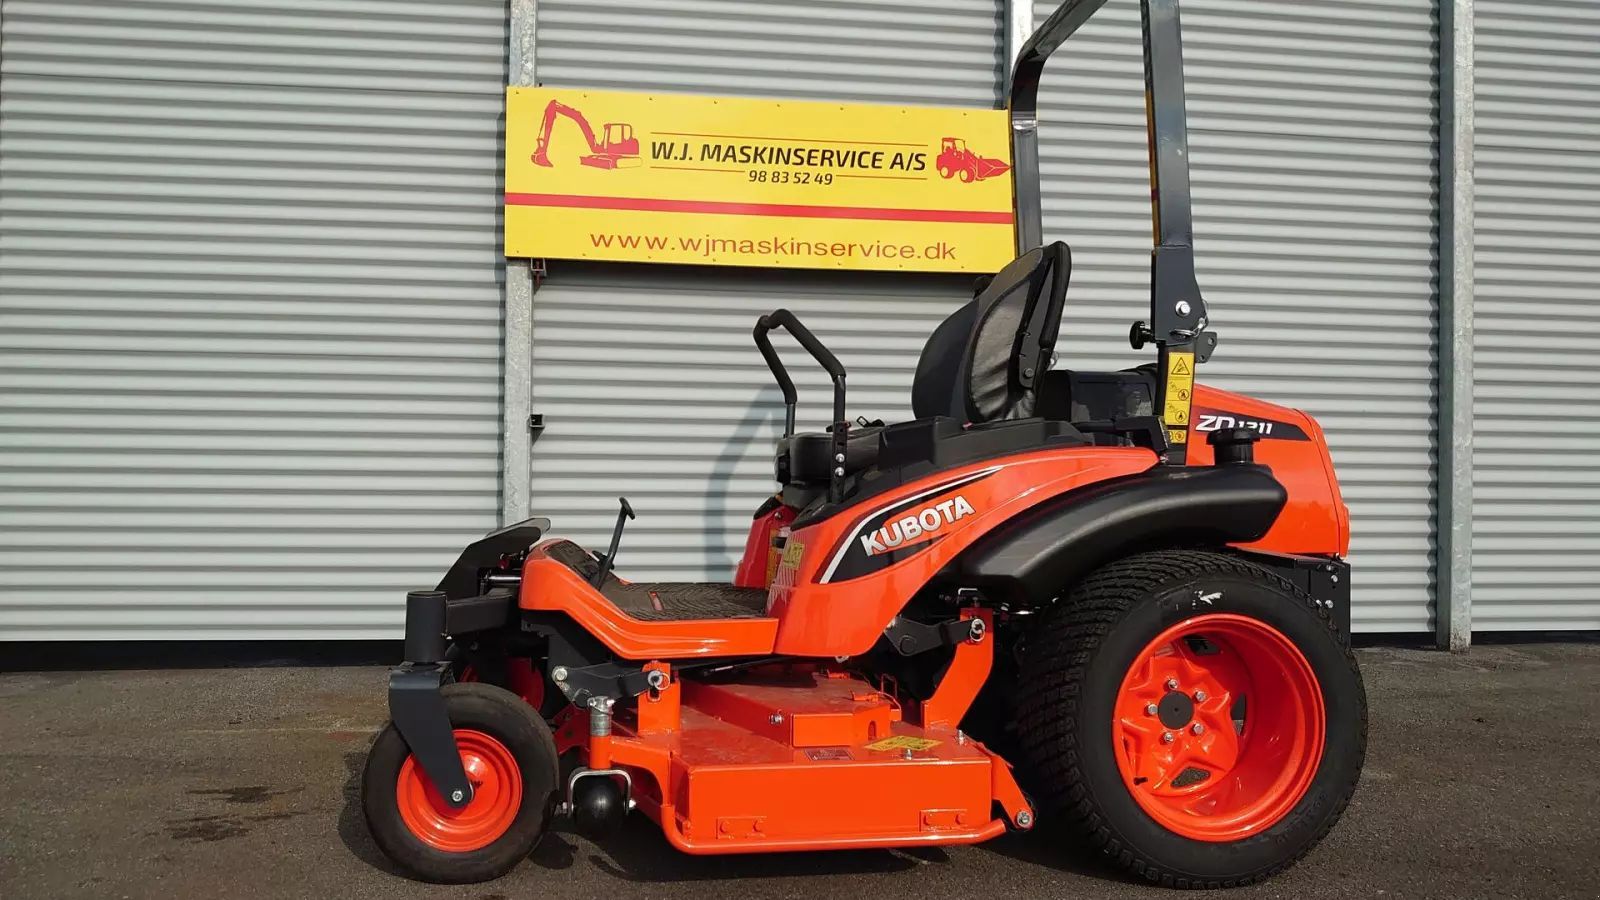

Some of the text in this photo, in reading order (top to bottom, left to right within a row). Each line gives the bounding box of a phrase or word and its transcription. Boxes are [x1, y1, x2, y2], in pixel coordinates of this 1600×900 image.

[651, 141, 927, 171] W.J. MASKINSERVICE A/S
[749, 170, 833, 186] 98 83 52 49
[590, 233, 957, 260] www.wjmaskinservice.dk
[860, 495, 976, 557] KUBOTA
